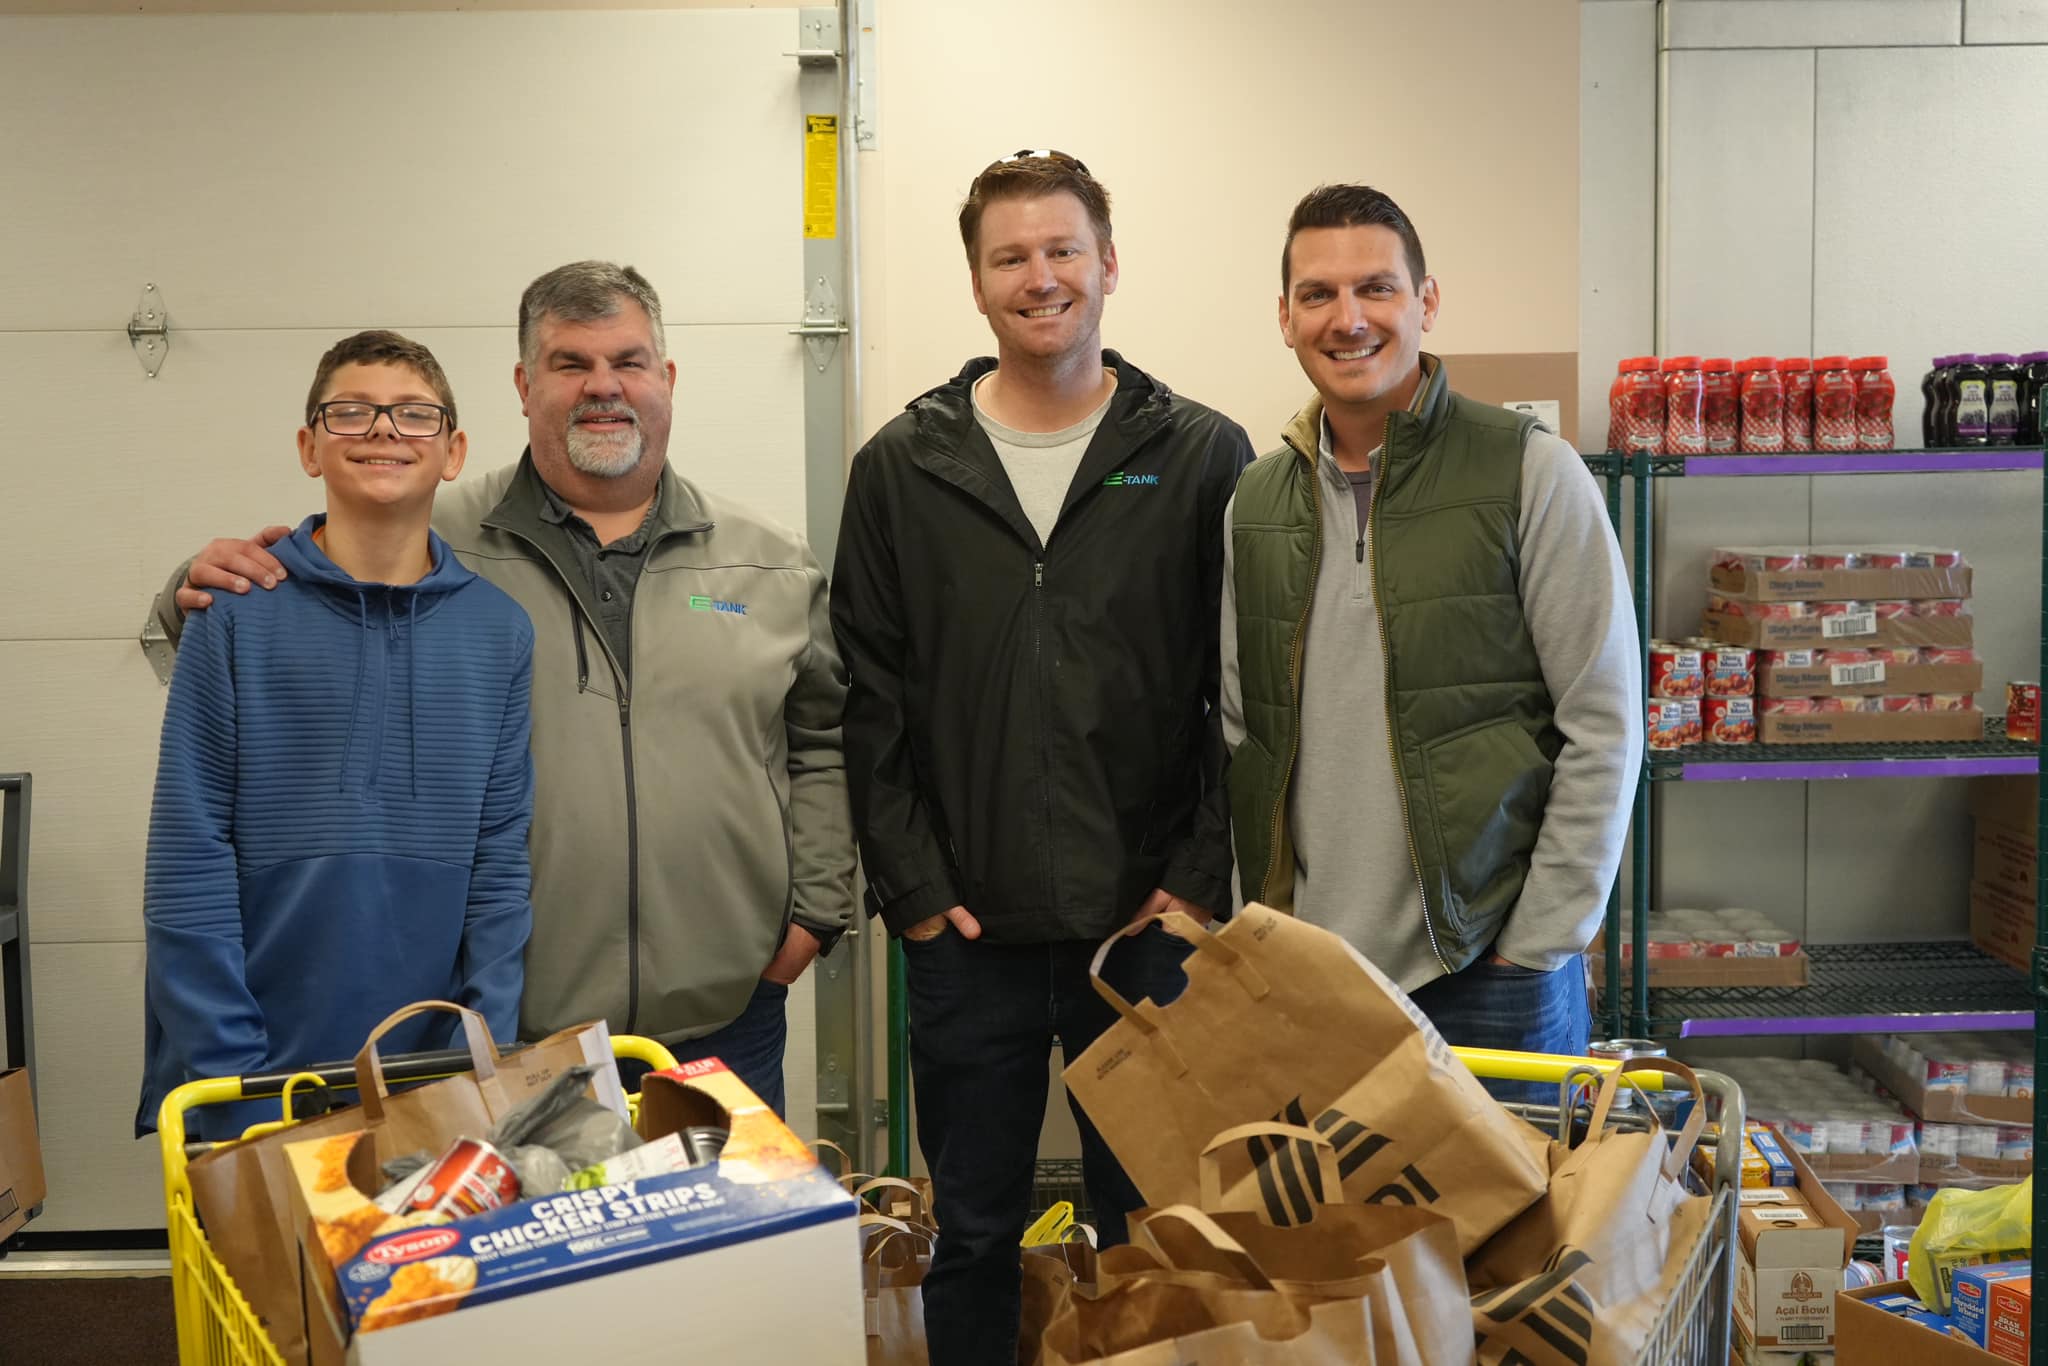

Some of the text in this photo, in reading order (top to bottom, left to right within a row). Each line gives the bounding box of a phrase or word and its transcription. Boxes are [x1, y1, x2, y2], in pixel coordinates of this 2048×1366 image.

[1103, 471, 1160, 486] E-TANK
[531, 1181, 637, 1220] CRISPY
[469, 1182, 718, 1255] CHICKEN STRIPS
[372, 1234, 451, 1259] Tyson
[1801, 1305, 1830, 1315] Bowl
